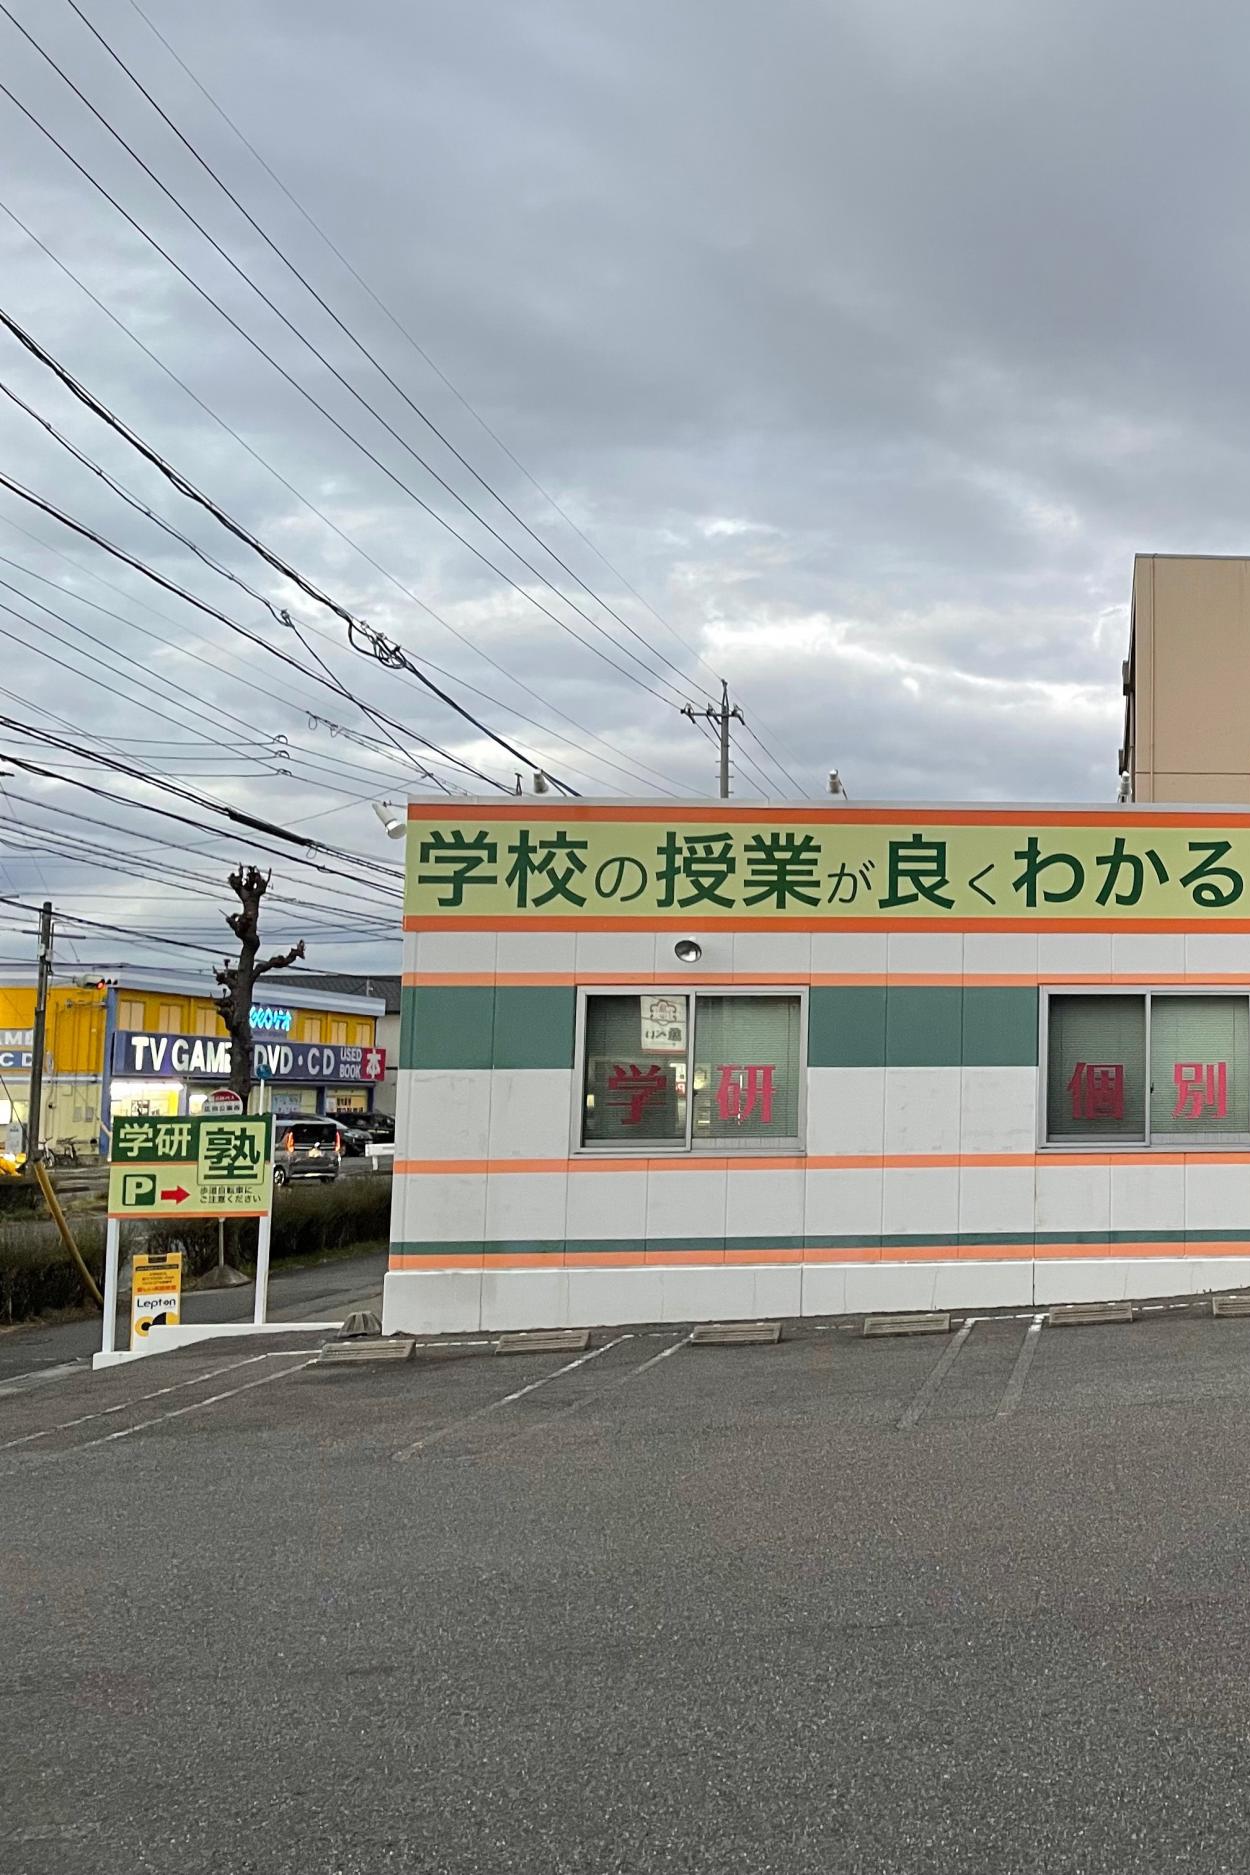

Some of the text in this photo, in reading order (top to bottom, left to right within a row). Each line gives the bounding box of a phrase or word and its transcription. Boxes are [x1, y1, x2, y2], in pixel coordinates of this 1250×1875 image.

[417, 829, 1245, 910] 学校の授業が良くわかる
[131, 1036, 168, 1072] TV
[341, 1047, 362, 1062] USED
[366, 1050, 381, 1079] 本
[339, 1064, 361, 1079] BOOK
[119, 1123, 192, 1157] 学研
[203, 1127, 261, 1180] 塾
[137, 1298, 176, 1309] Lepton
